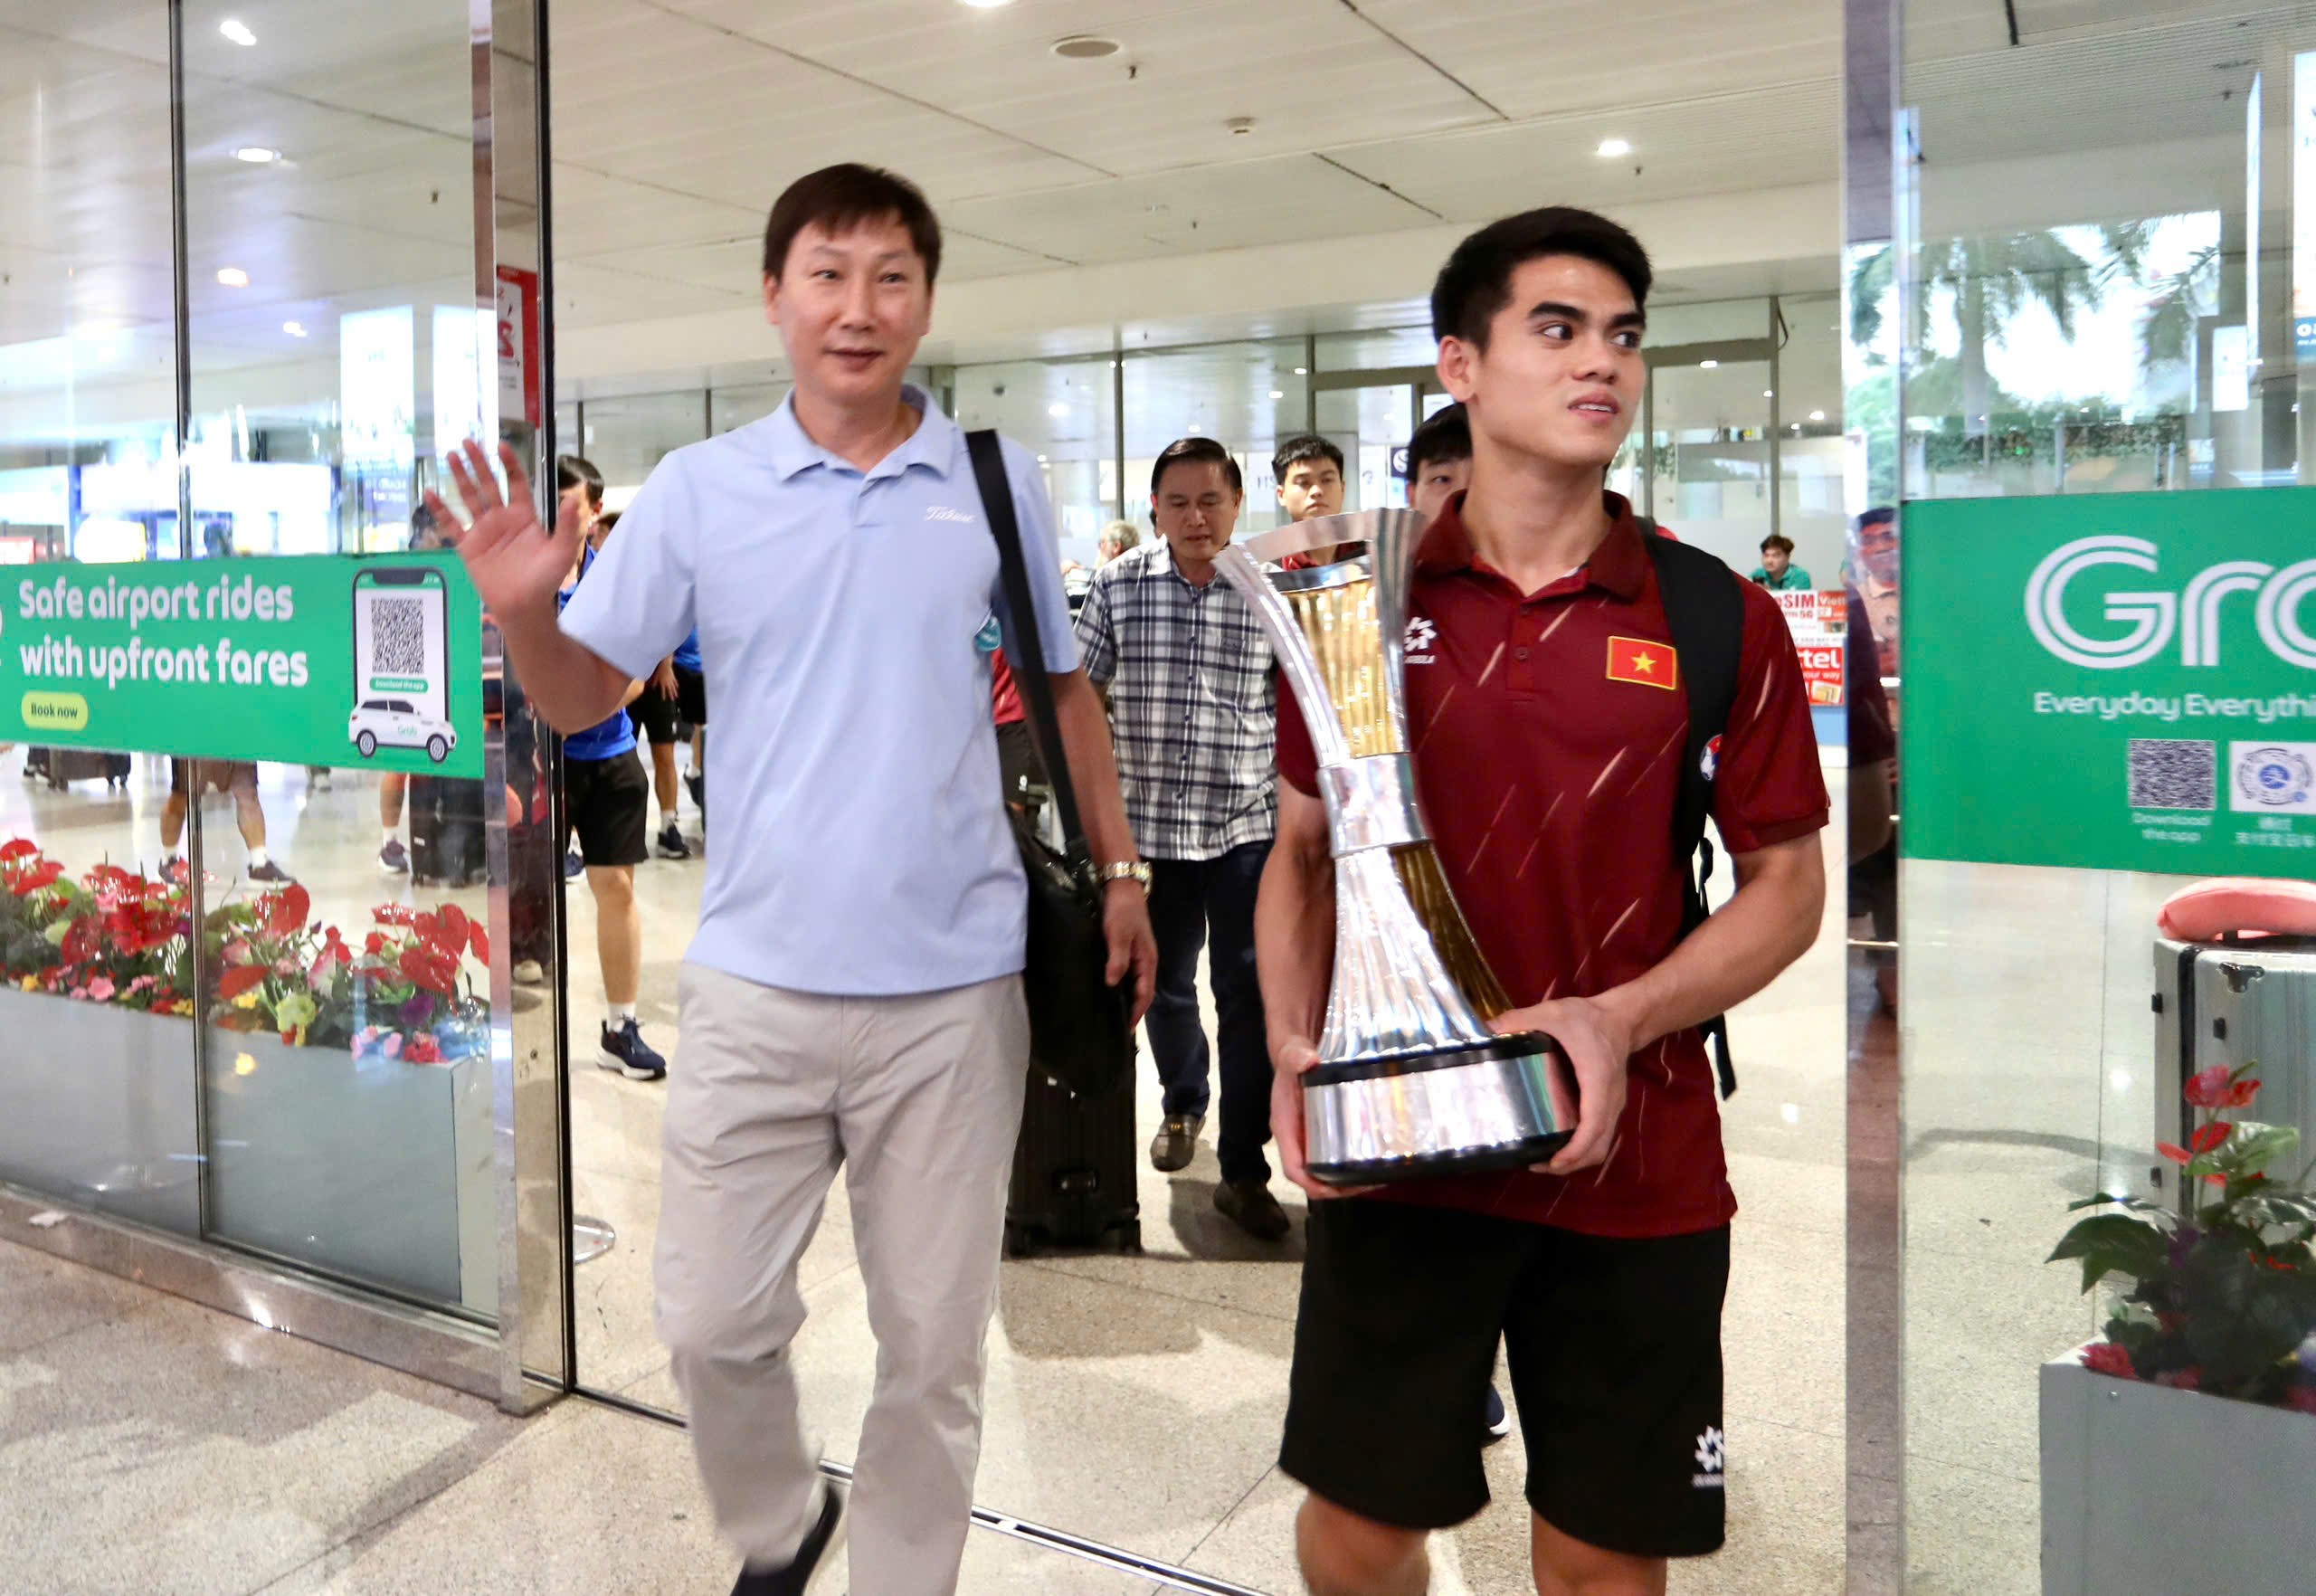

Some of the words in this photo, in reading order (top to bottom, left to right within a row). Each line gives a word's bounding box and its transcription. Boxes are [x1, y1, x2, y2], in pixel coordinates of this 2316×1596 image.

[18, 576, 84, 620] Safe
[88, 575, 200, 631] airport
[205, 574, 294, 622] rides
[19, 633, 83, 678] with
[89, 635, 210, 690] upfront
[215, 637, 308, 688] fares
[31, 702, 54, 717] Book
[57, 706, 78, 718] now
[2034, 690, 2180, 722] Everyday
